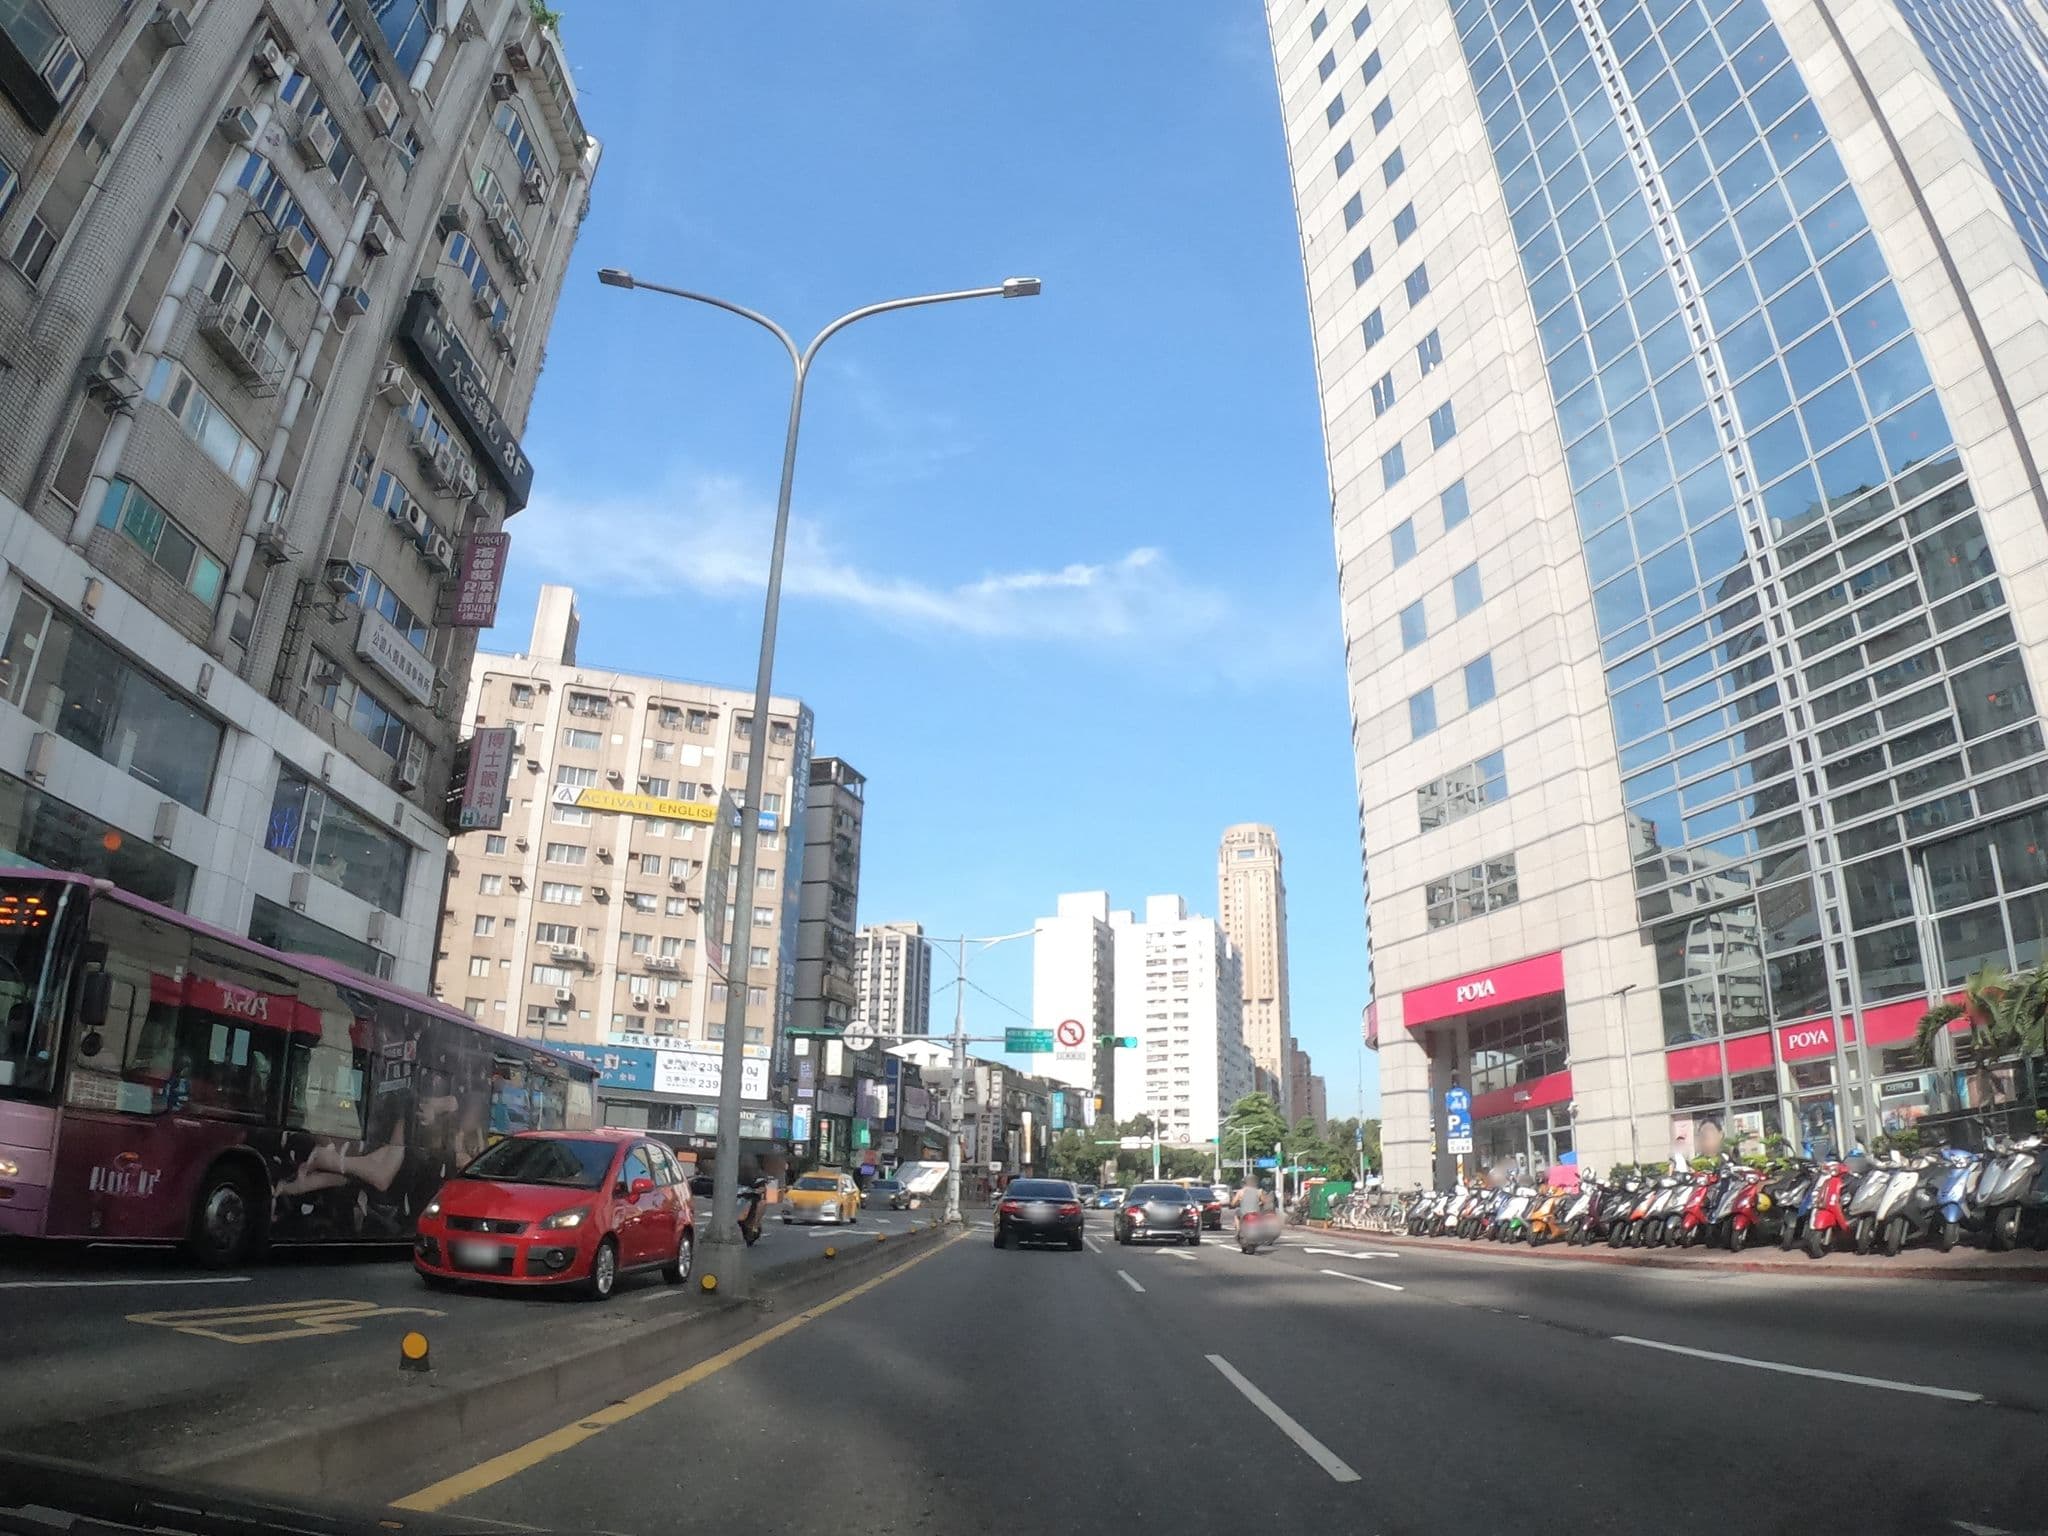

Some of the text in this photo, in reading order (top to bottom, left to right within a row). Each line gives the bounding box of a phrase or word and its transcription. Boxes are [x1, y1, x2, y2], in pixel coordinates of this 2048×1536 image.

[503, 442, 526, 477] 8F
[477, 733, 505, 808] 博士眼科
[581, 792, 654, 813] ACTIVATE
[1456, 978, 1496, 1003] POYA
[1788, 1028, 1829, 1050] POYA
[1447, 1114, 1461, 1132] P
